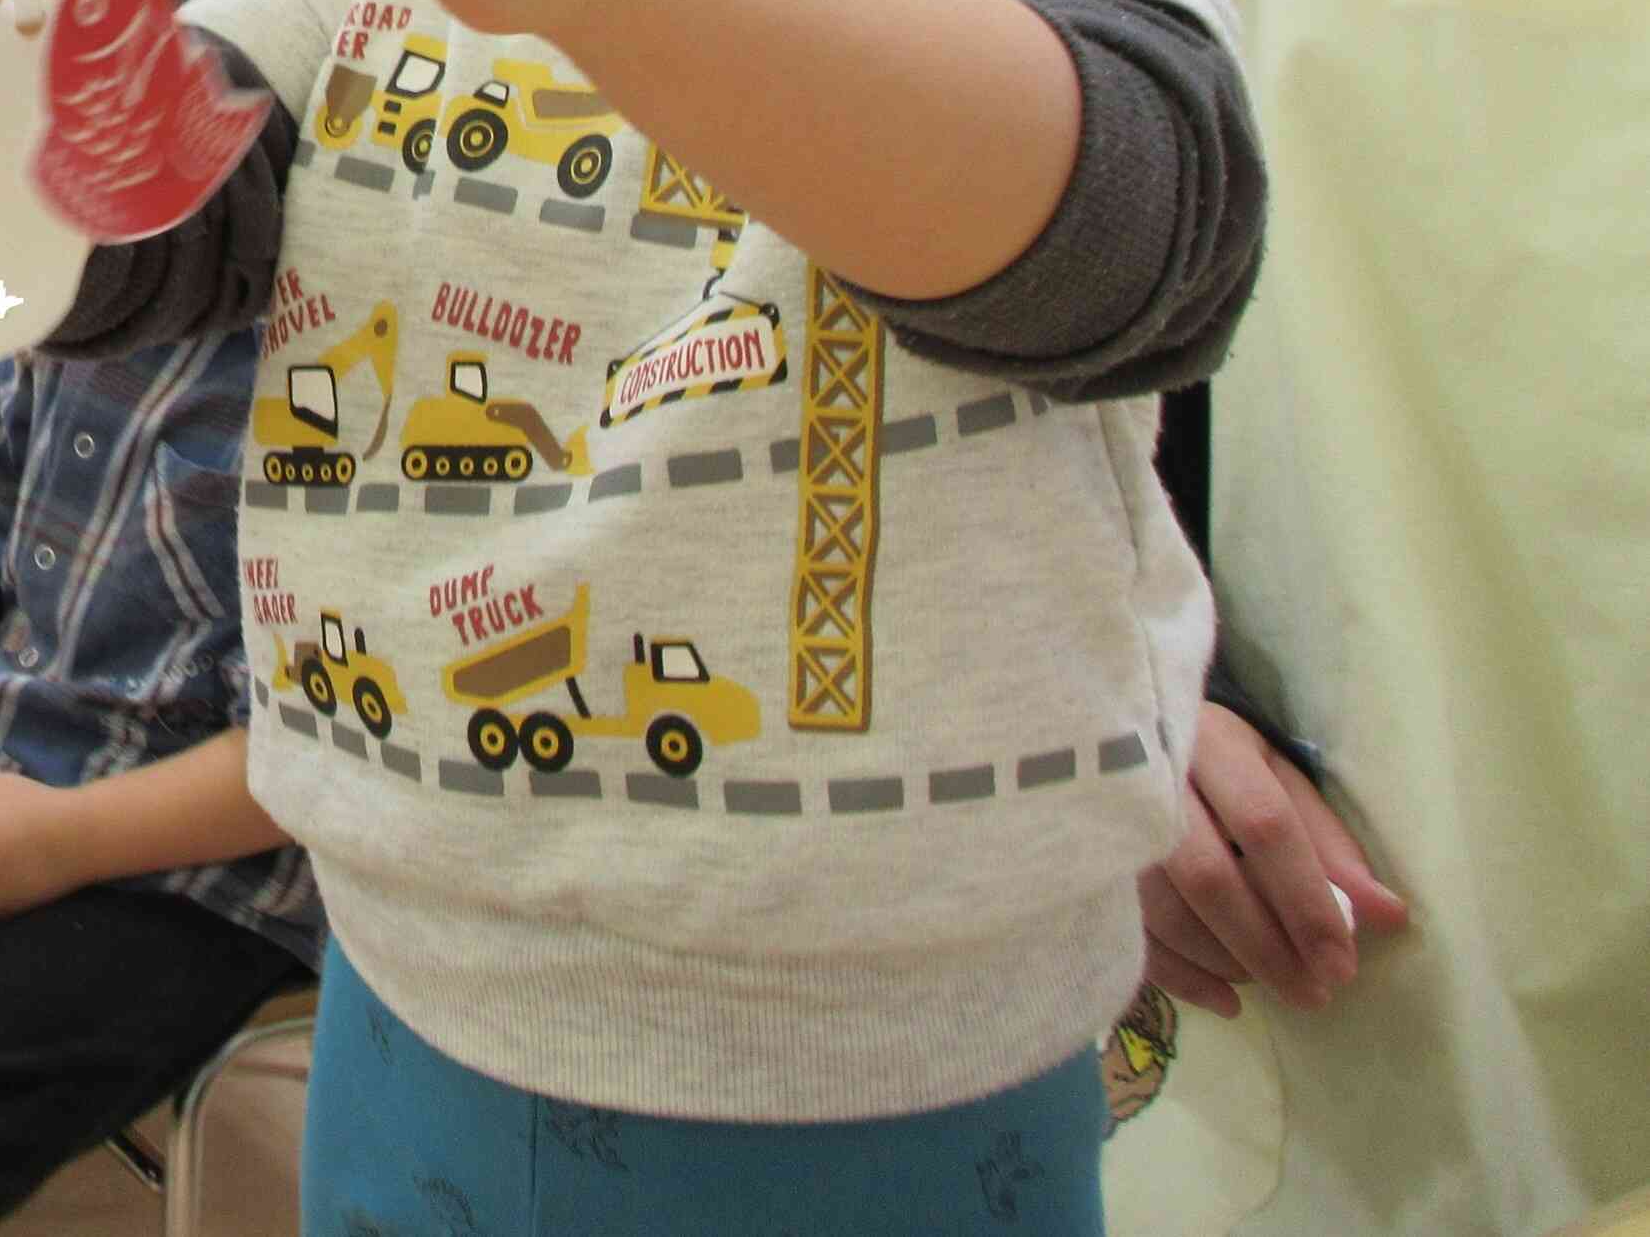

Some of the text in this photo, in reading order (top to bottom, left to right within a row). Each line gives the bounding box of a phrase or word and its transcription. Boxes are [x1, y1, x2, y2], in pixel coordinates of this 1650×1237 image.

[431, 281, 582, 366] BULLDOZER
[620, 328, 765, 404] CONSTRUCTION
[429, 563, 494, 618] DUMP
[451, 582, 544, 646] TRUCK
